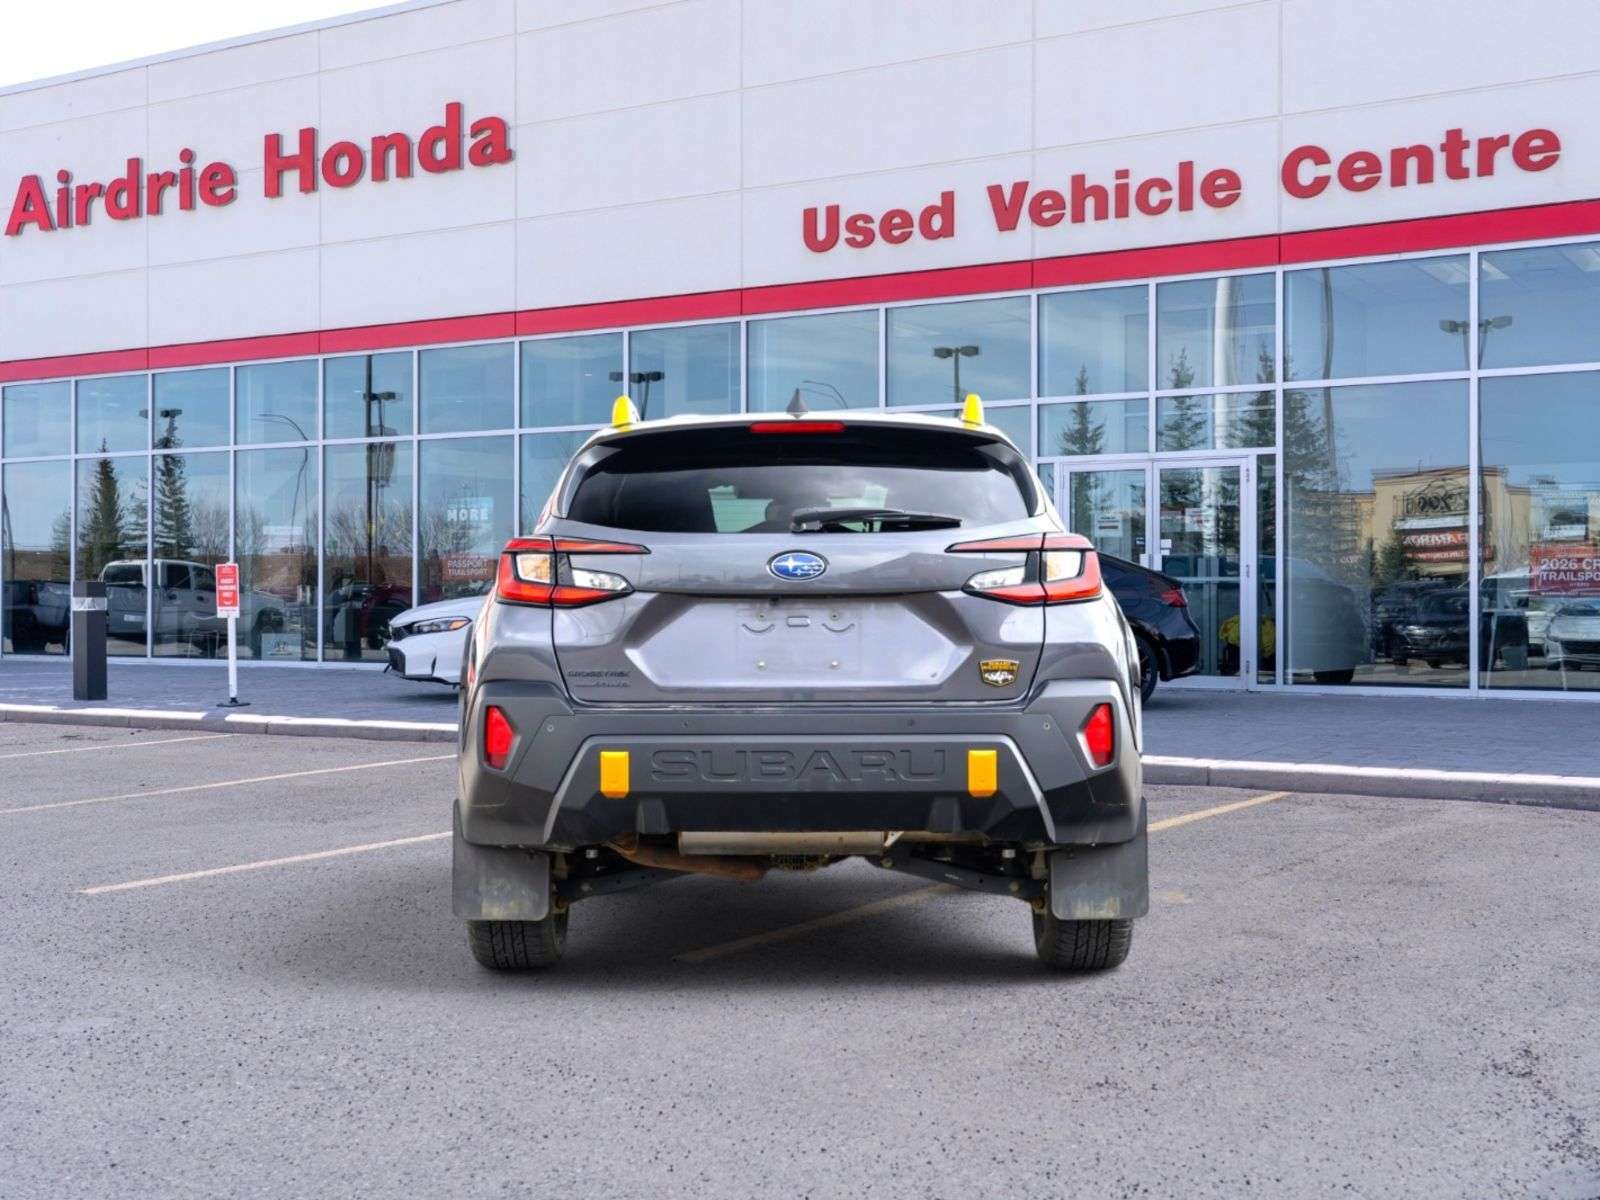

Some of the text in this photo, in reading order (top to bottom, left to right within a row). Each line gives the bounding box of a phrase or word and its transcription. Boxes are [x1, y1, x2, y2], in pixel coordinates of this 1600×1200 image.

[5, 102, 514, 236] Airdrie Honda
[803, 127, 1561, 252] Used Vehicle Centre
[447, 508, 489, 521] MORE
[1541, 558, 1578, 570] 2026
[651, 749, 946, 783] SUBARU
